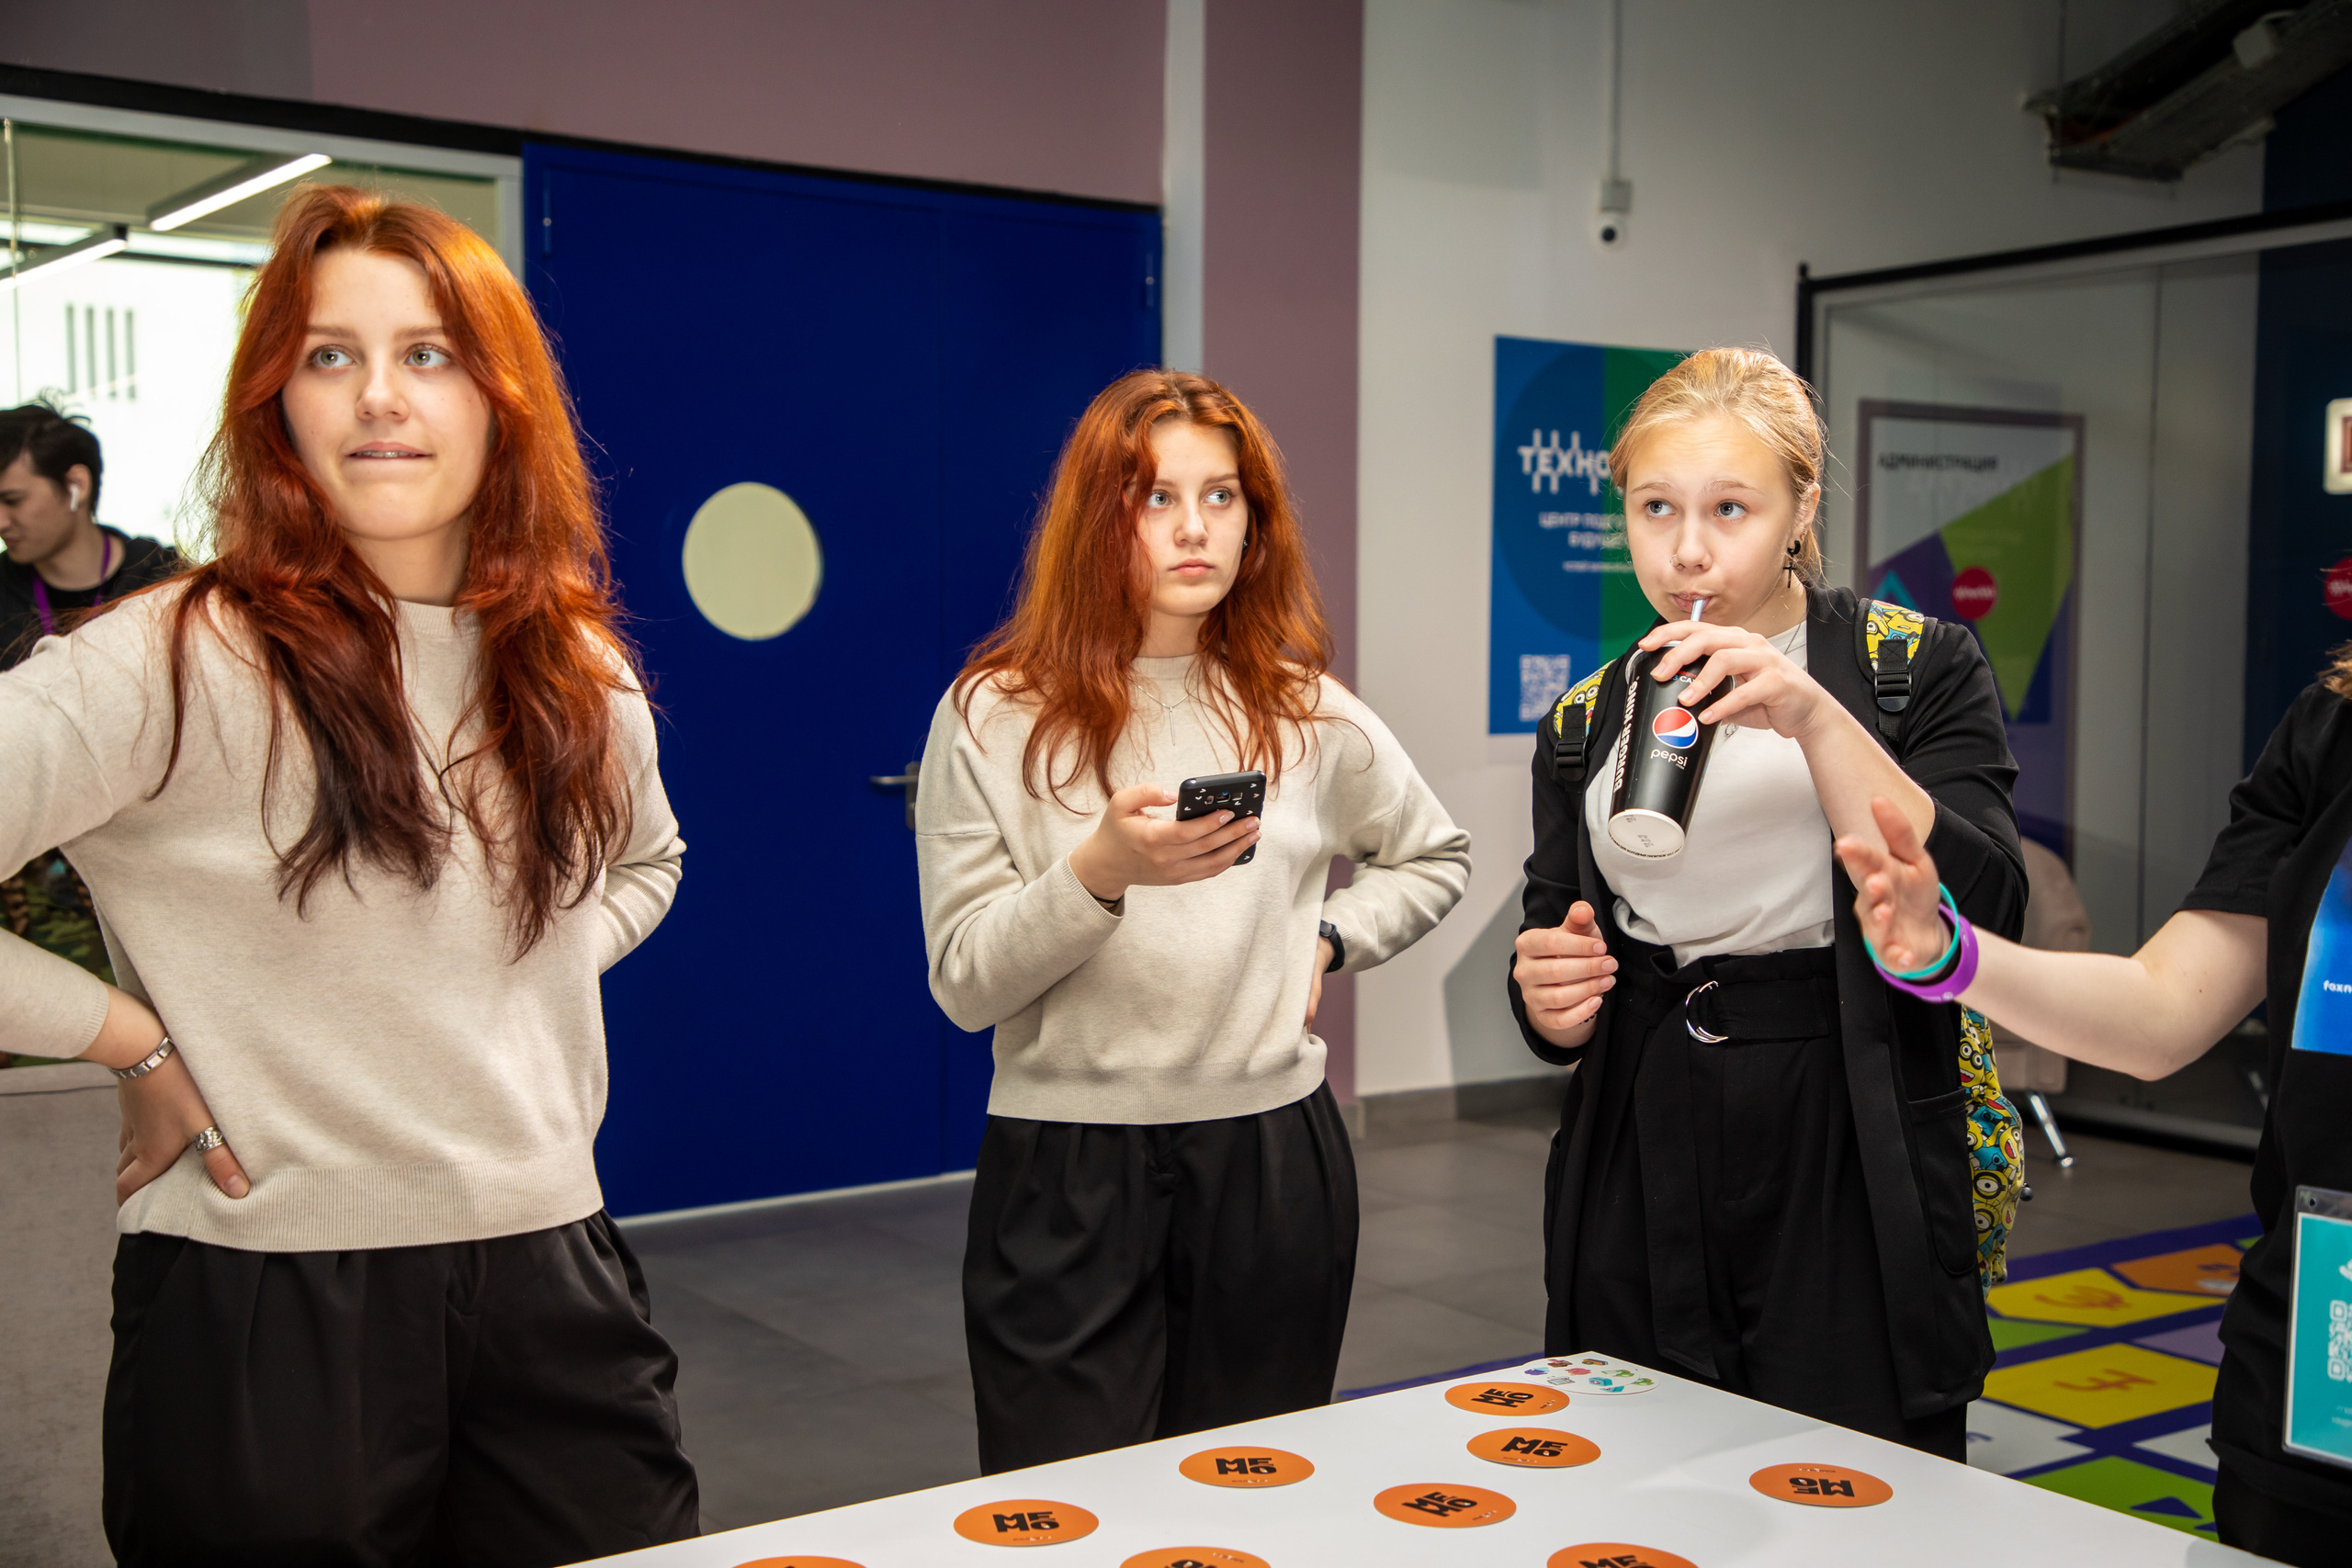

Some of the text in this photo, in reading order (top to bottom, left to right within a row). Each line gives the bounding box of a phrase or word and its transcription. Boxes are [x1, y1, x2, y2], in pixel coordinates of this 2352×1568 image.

[1517, 429, 1623, 496] ТЕХНО
[1613, 680, 1638, 793] BURGER KING
[1650, 749, 1688, 767] pepsi
